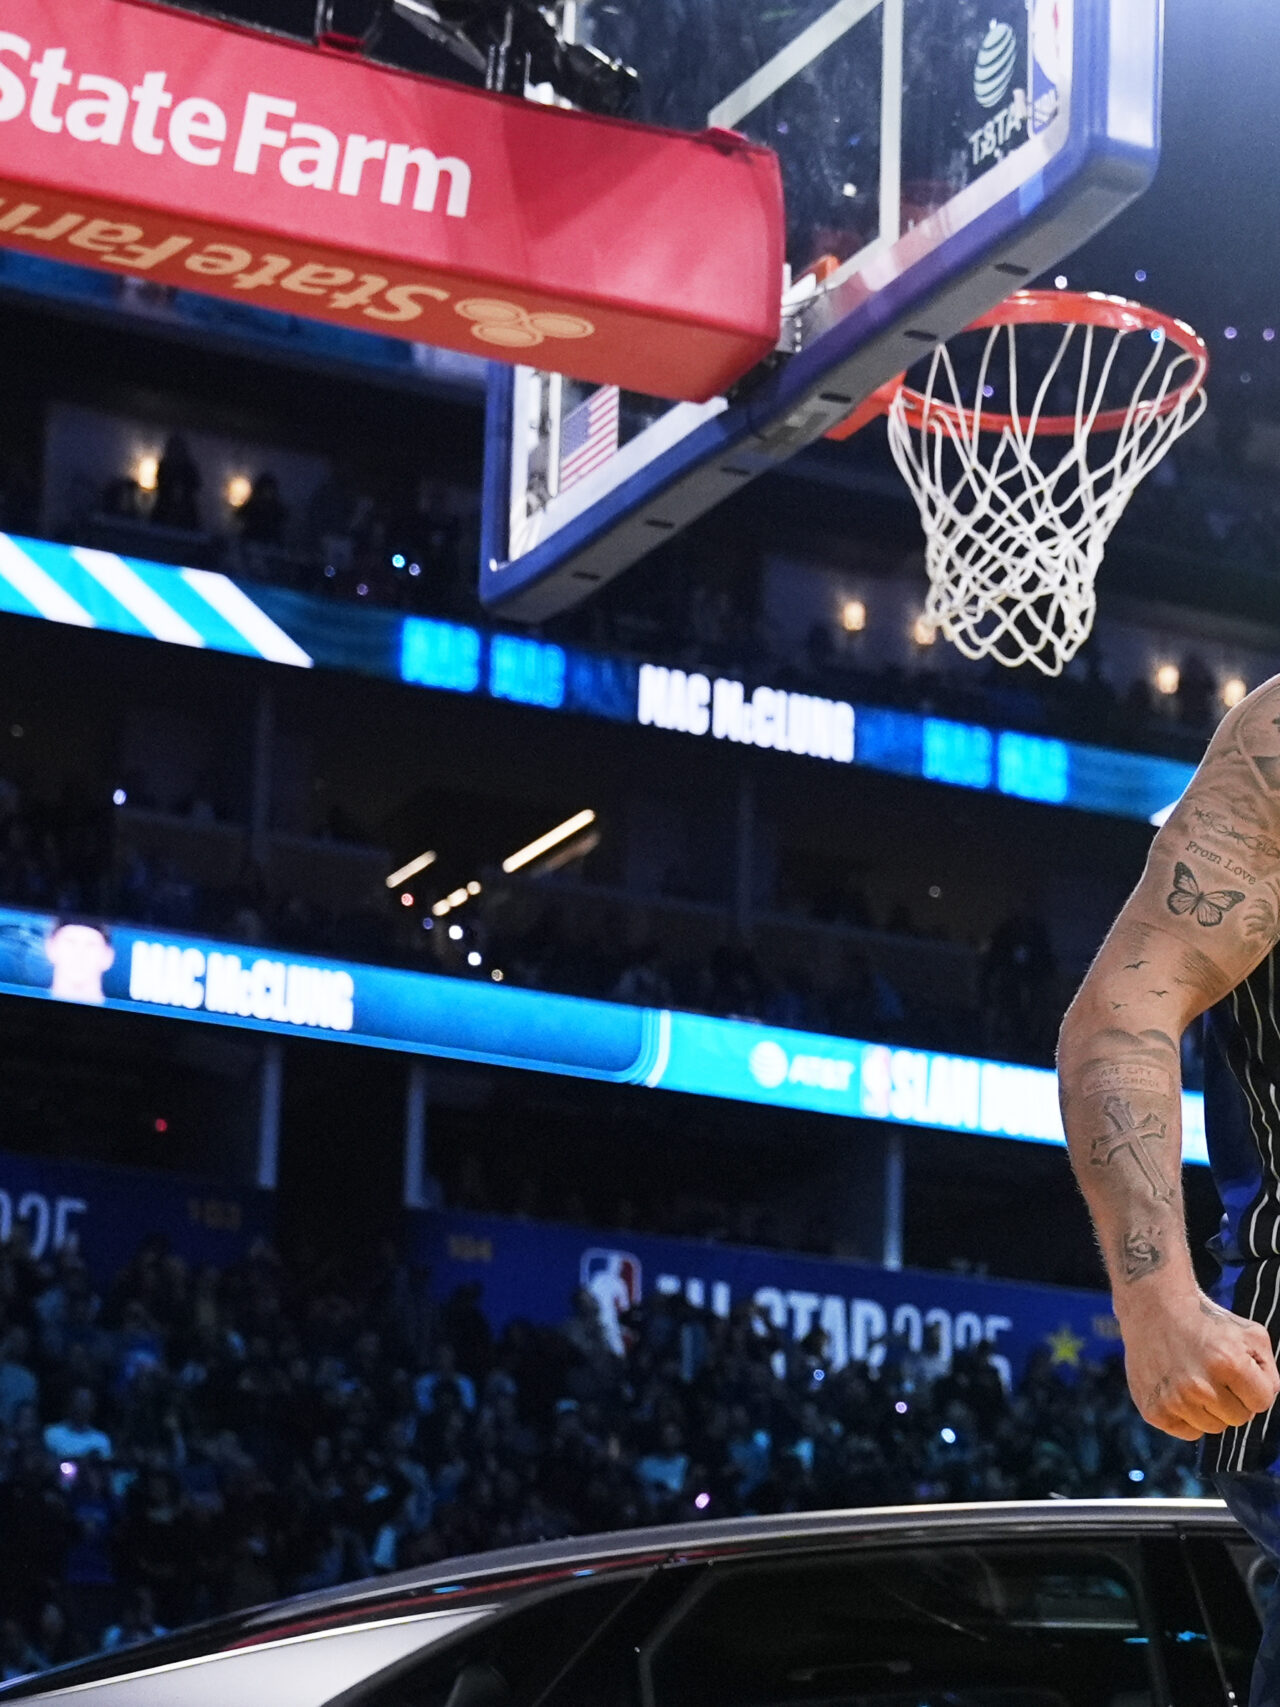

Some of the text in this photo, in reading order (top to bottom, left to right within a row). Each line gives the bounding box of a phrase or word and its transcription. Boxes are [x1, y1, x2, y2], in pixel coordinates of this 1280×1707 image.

[233, 91, 472, 218] Farm
[1184, 840, 1257, 885] From Love
